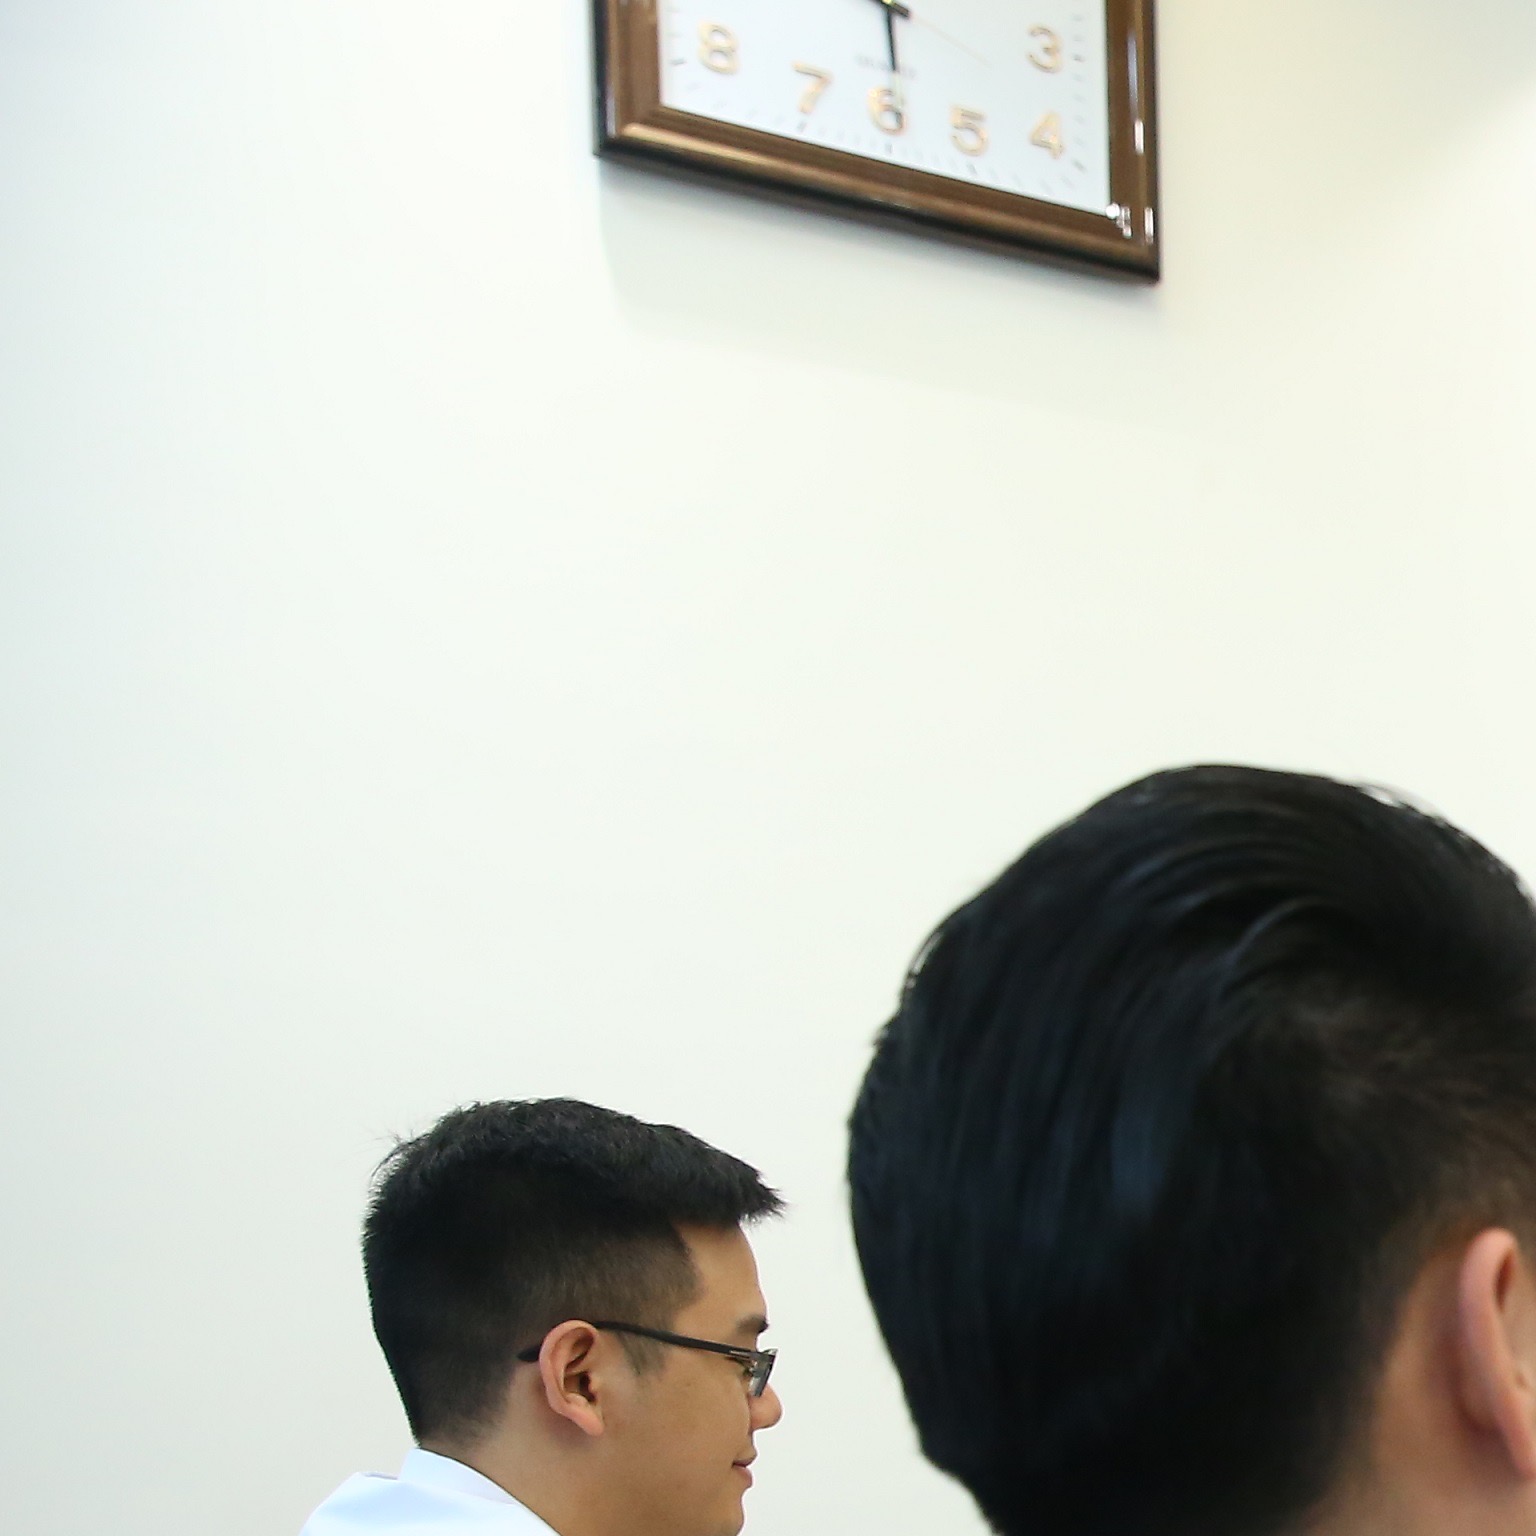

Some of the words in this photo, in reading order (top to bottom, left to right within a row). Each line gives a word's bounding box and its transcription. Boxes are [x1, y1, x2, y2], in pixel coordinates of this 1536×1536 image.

[699, 22, 740, 75] 8
[1026, 24, 1064, 74] 3
[792, 60, 832, 115] 7
[867, 85, 906, 136] 6
[949, 104, 990, 156] 5
[1029, 111, 1065, 160] 4
